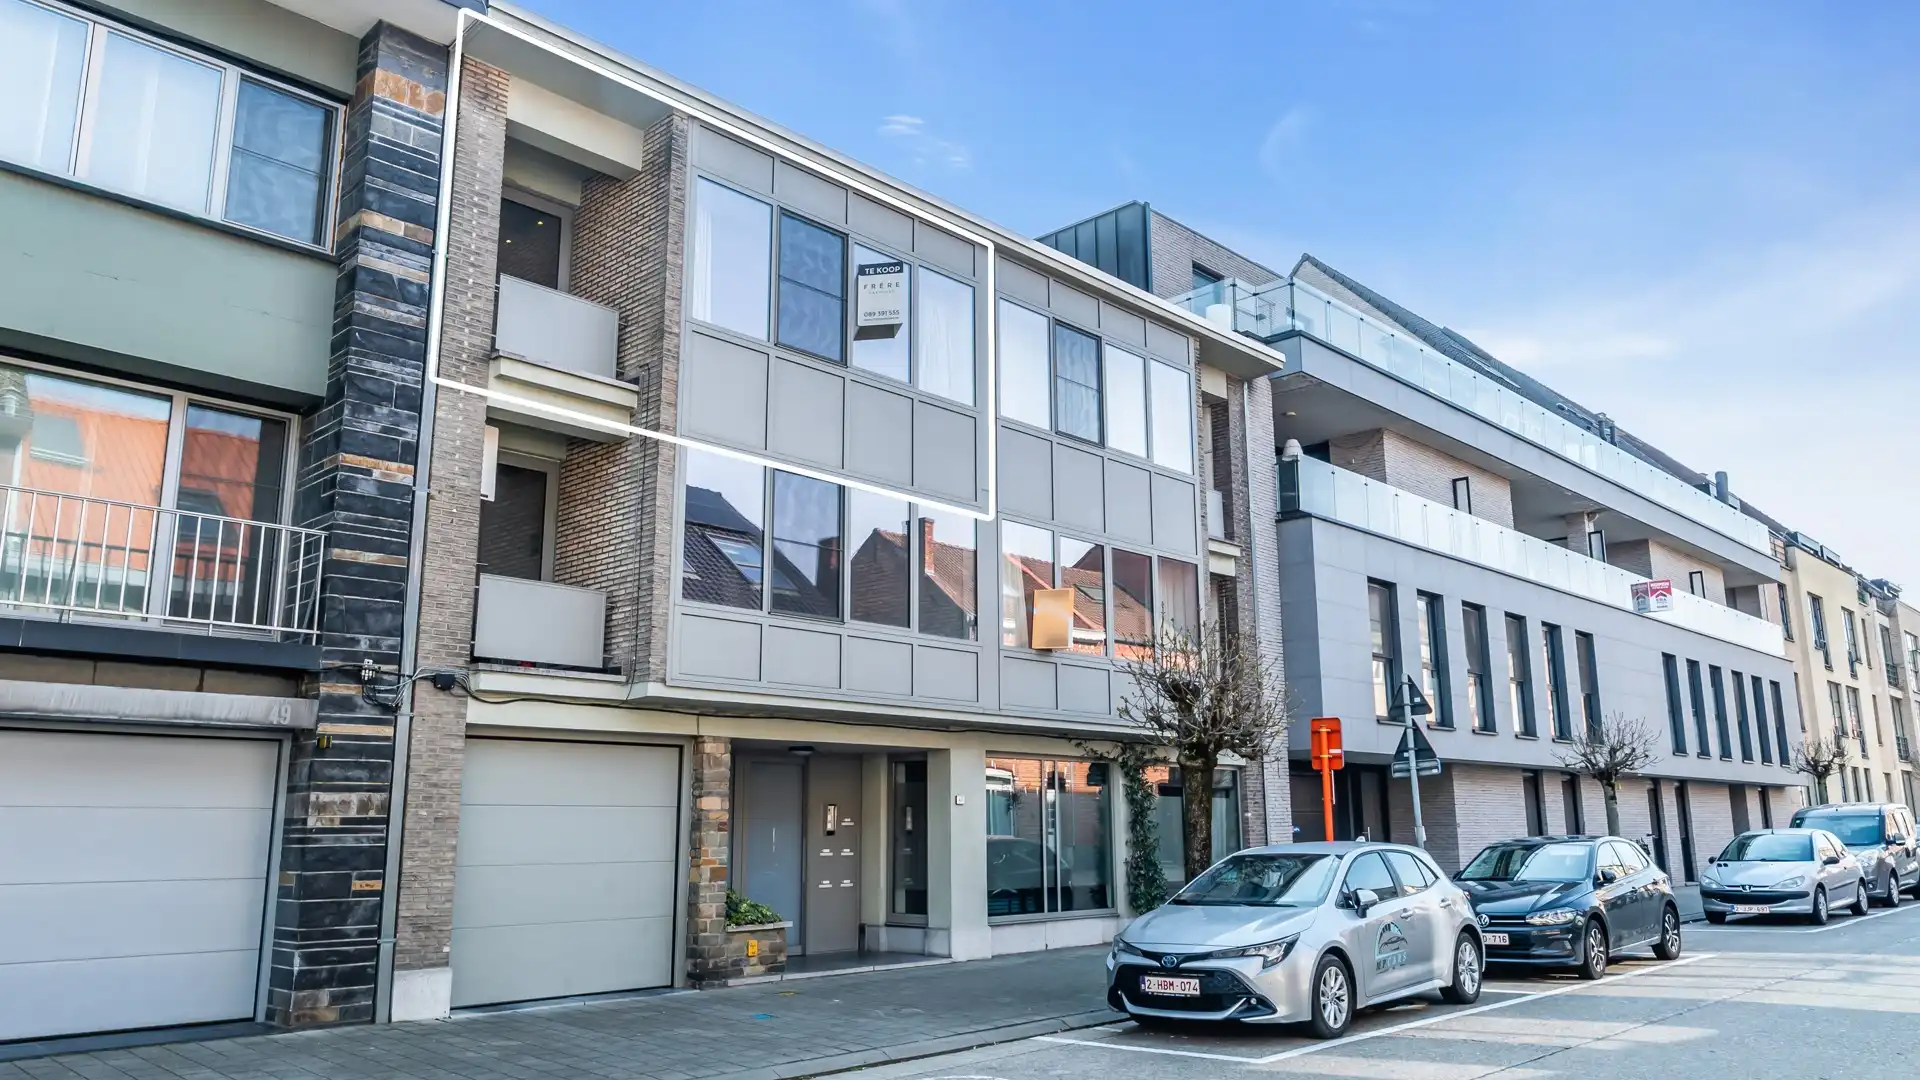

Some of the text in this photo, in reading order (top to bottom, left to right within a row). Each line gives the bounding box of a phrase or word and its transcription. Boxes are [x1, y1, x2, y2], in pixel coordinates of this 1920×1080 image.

[864, 265, 901, 275] TE KOOP
[268, 703, 292, 725] 49
[1146, 979, 1199, 993] 2-HBM-074
